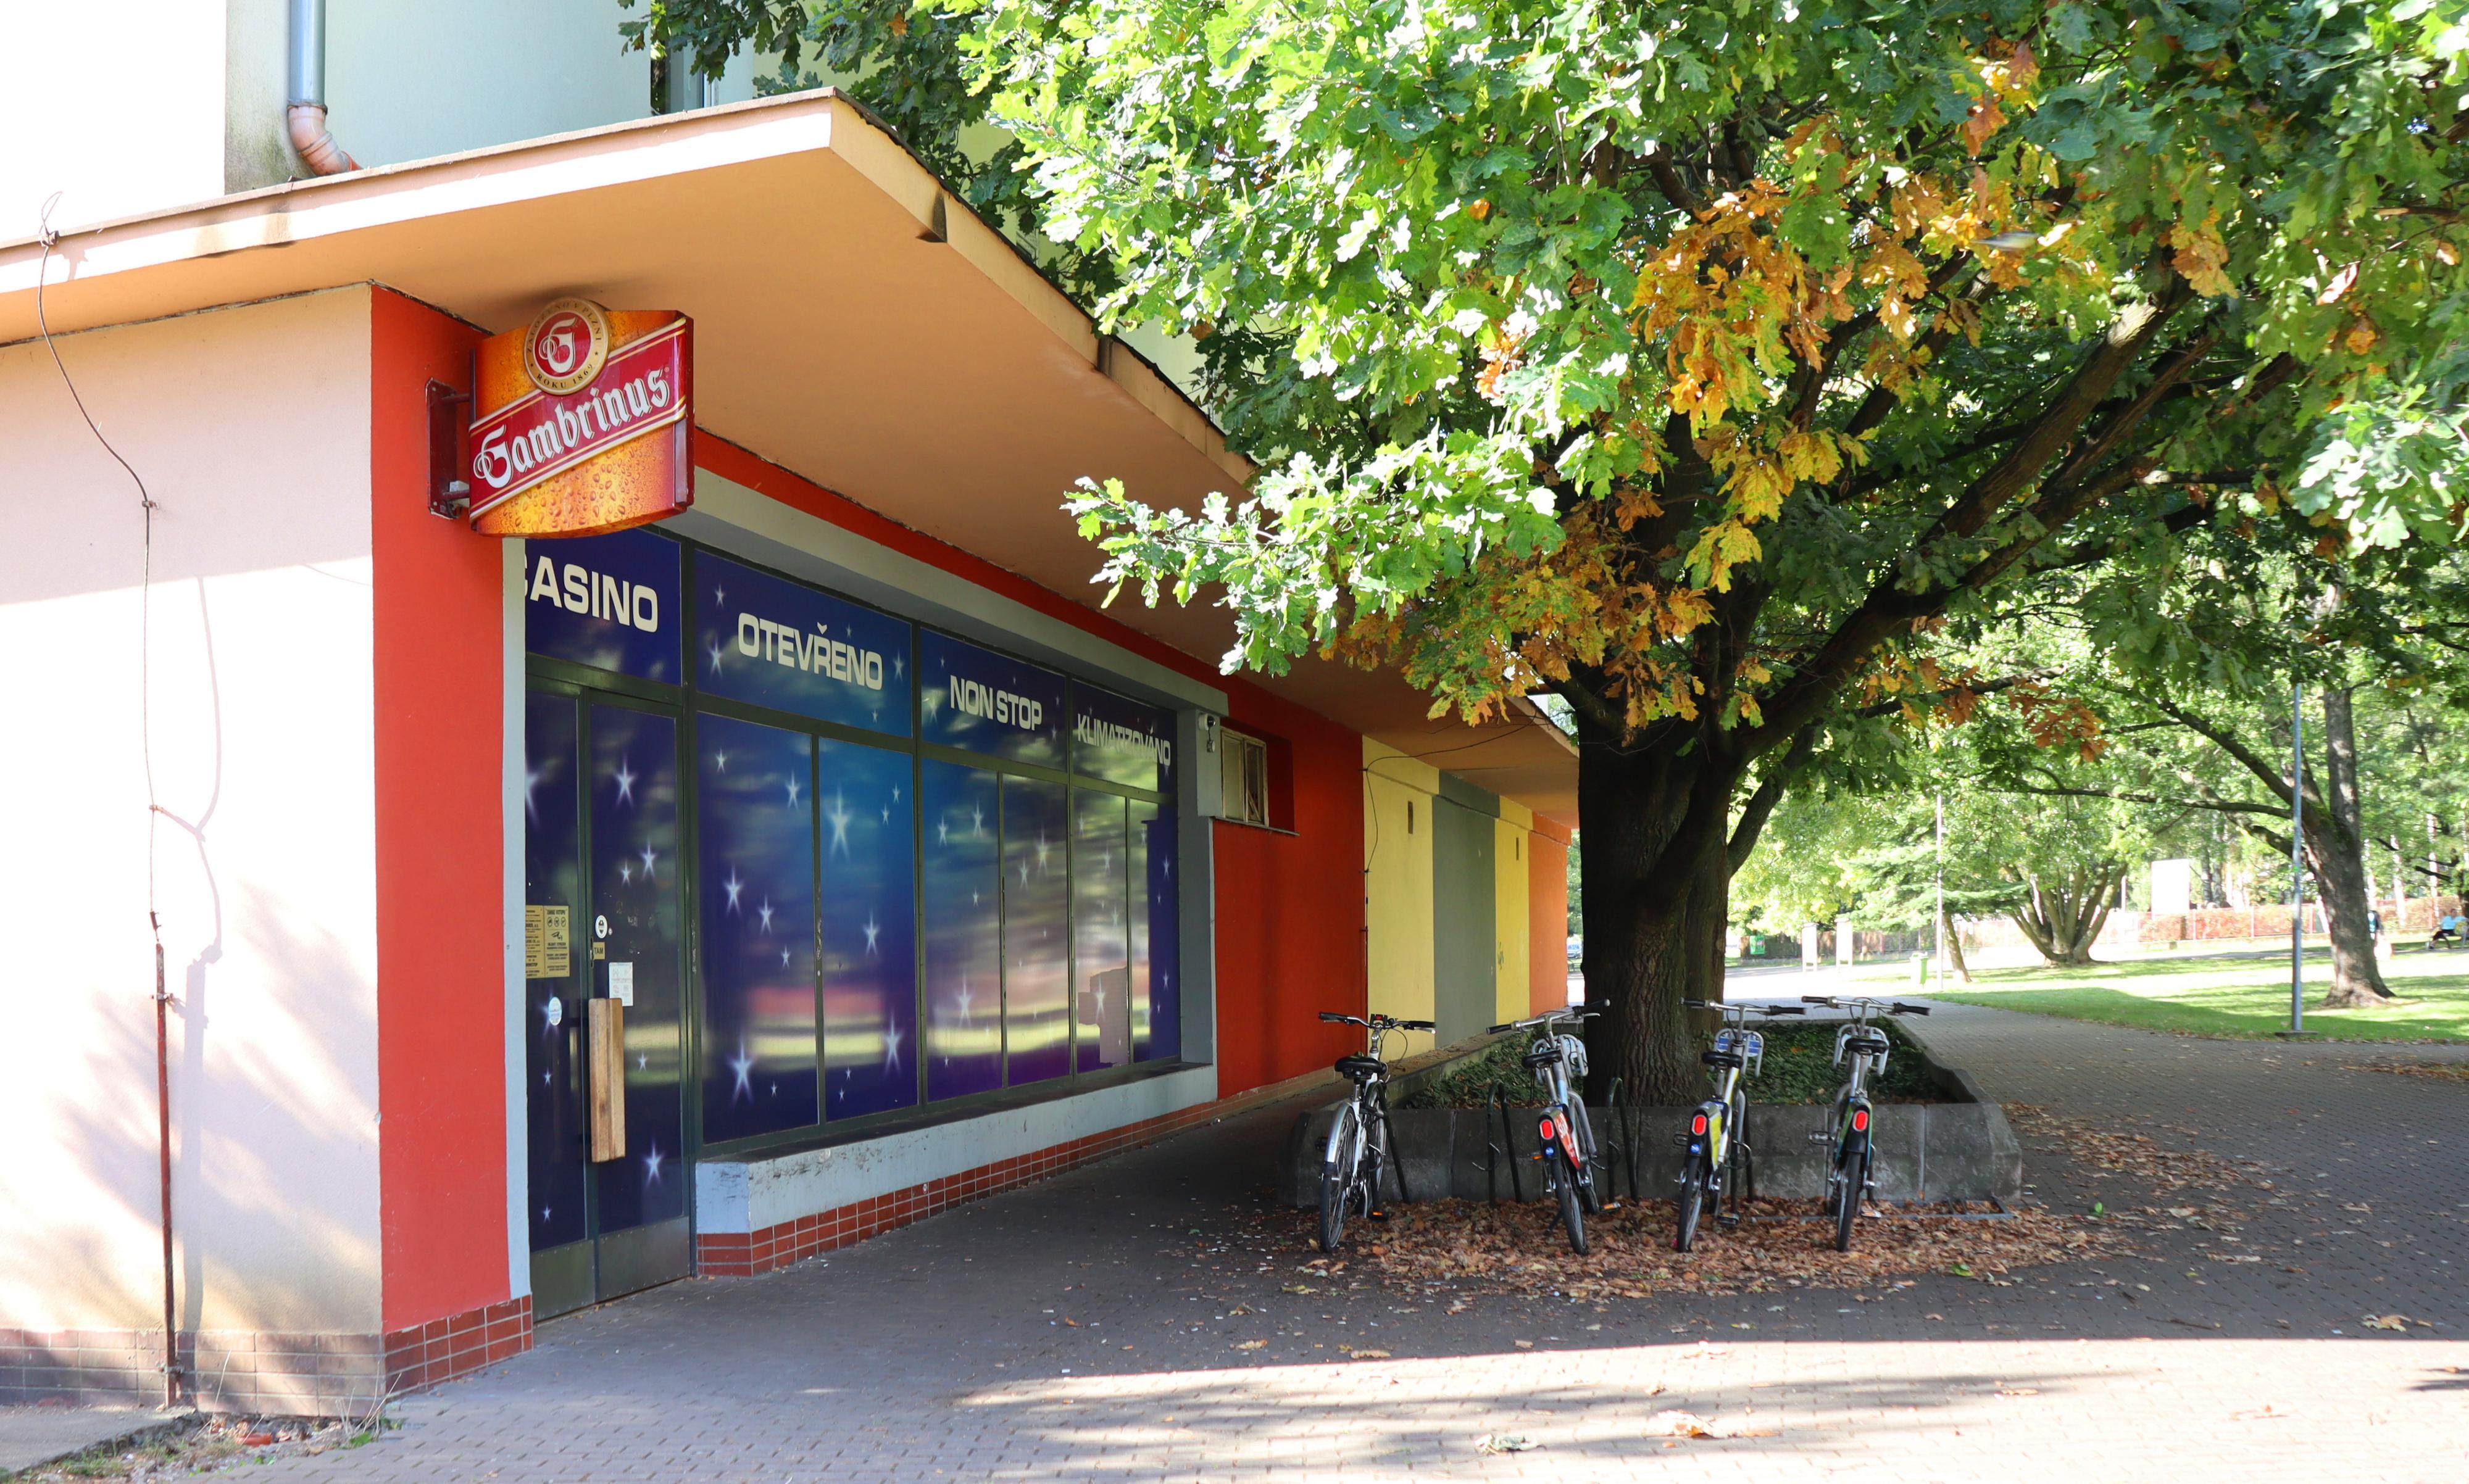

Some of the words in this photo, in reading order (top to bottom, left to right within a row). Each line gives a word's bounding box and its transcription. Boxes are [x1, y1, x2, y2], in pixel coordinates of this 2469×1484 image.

[536, 373, 567, 389] ROKU
[572, 363, 593, 384] 1869
[473, 368, 670, 489] Gambrinus
[737, 612, 883, 691] OTEVŘENO
[950, 674, 994, 720] NON
[996, 689, 1043, 731] STOP
[1077, 713, 1172, 767] KLIMATIZOVÁNO
[593, 947, 604, 955] TAM
